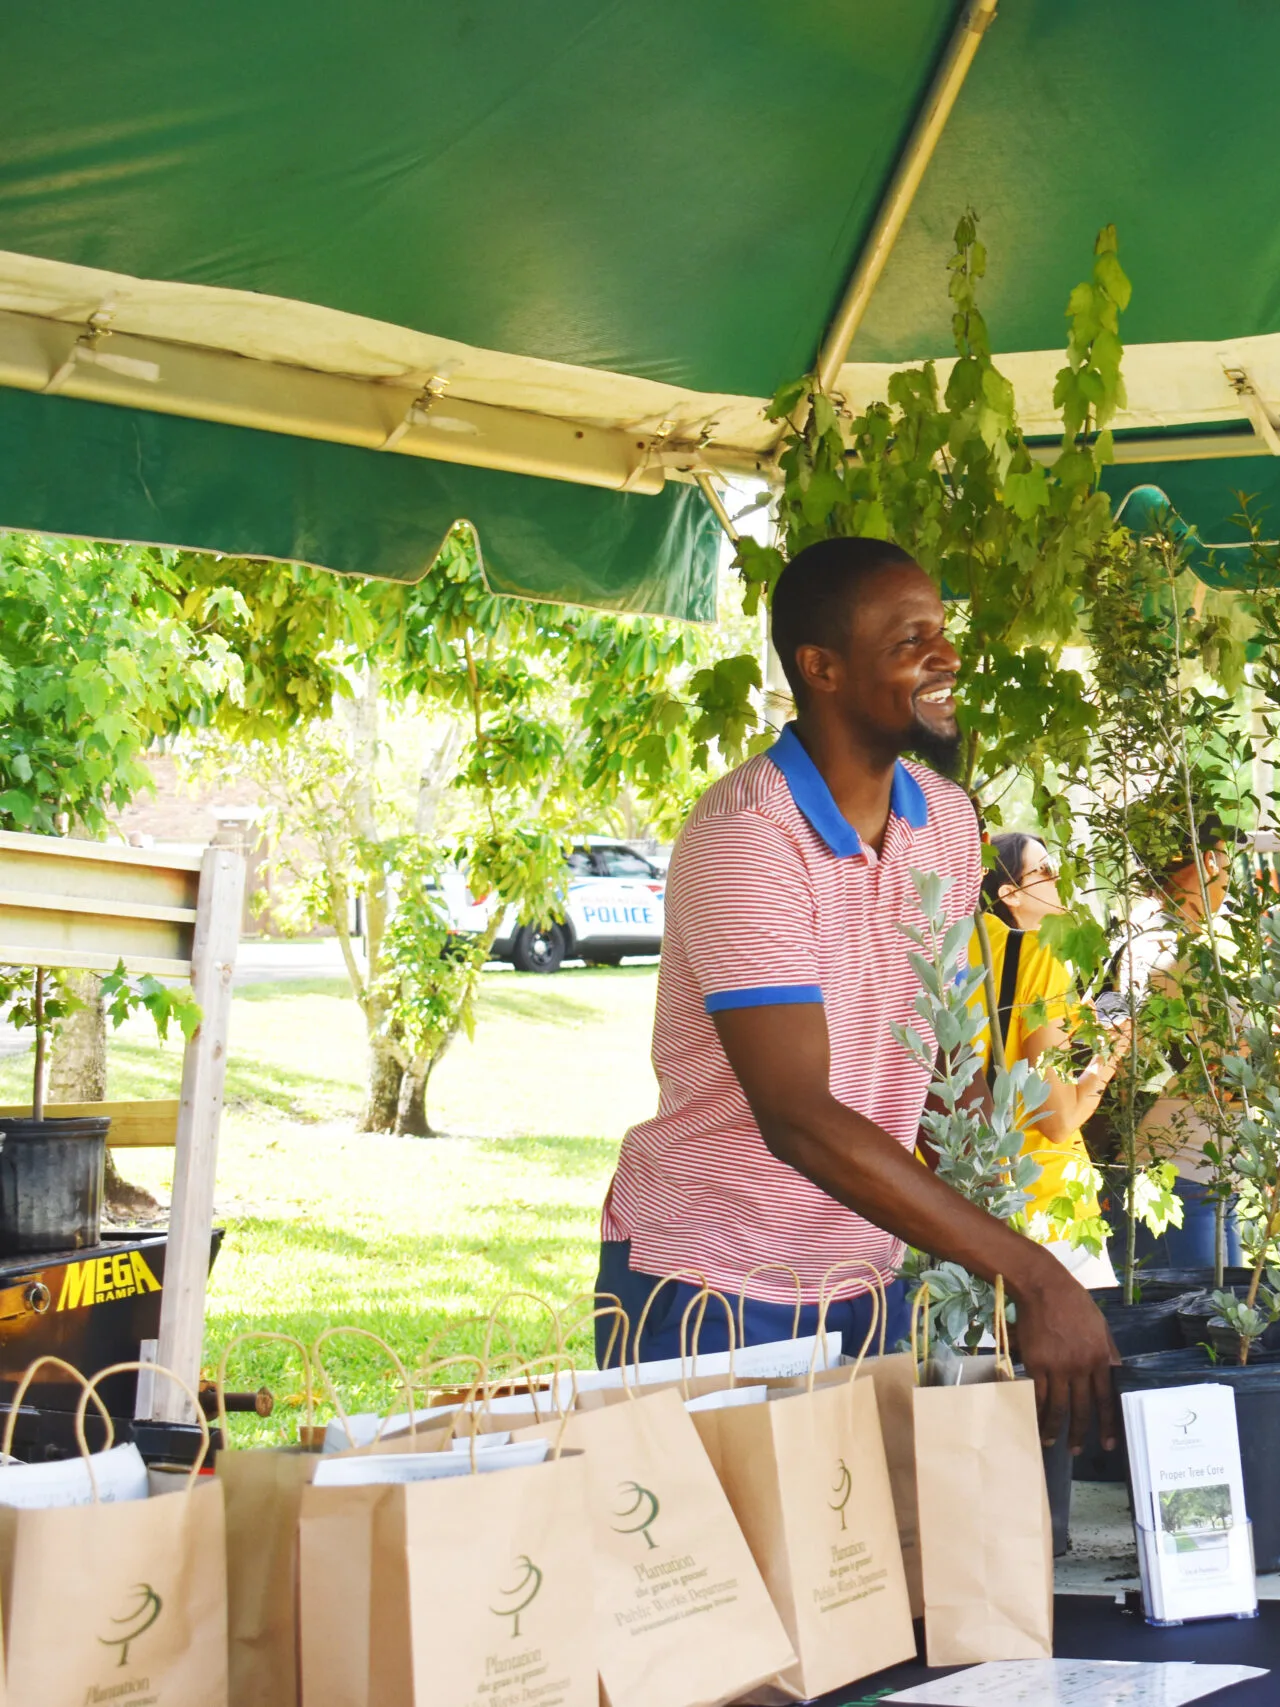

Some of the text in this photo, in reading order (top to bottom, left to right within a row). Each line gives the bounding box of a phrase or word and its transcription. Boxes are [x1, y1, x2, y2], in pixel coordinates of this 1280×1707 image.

[583, 906, 654, 924] POLICE
[56, 1250, 163, 1312] MEGA
[95, 1286, 136, 1304] RAMP
[1159, 1464, 1225, 1481] Proper Tree Care
[633, 1555, 697, 1582] Plantation
[614, 1579, 739, 1627] Public Works Department
[485, 1649, 542, 1677] Plantation
